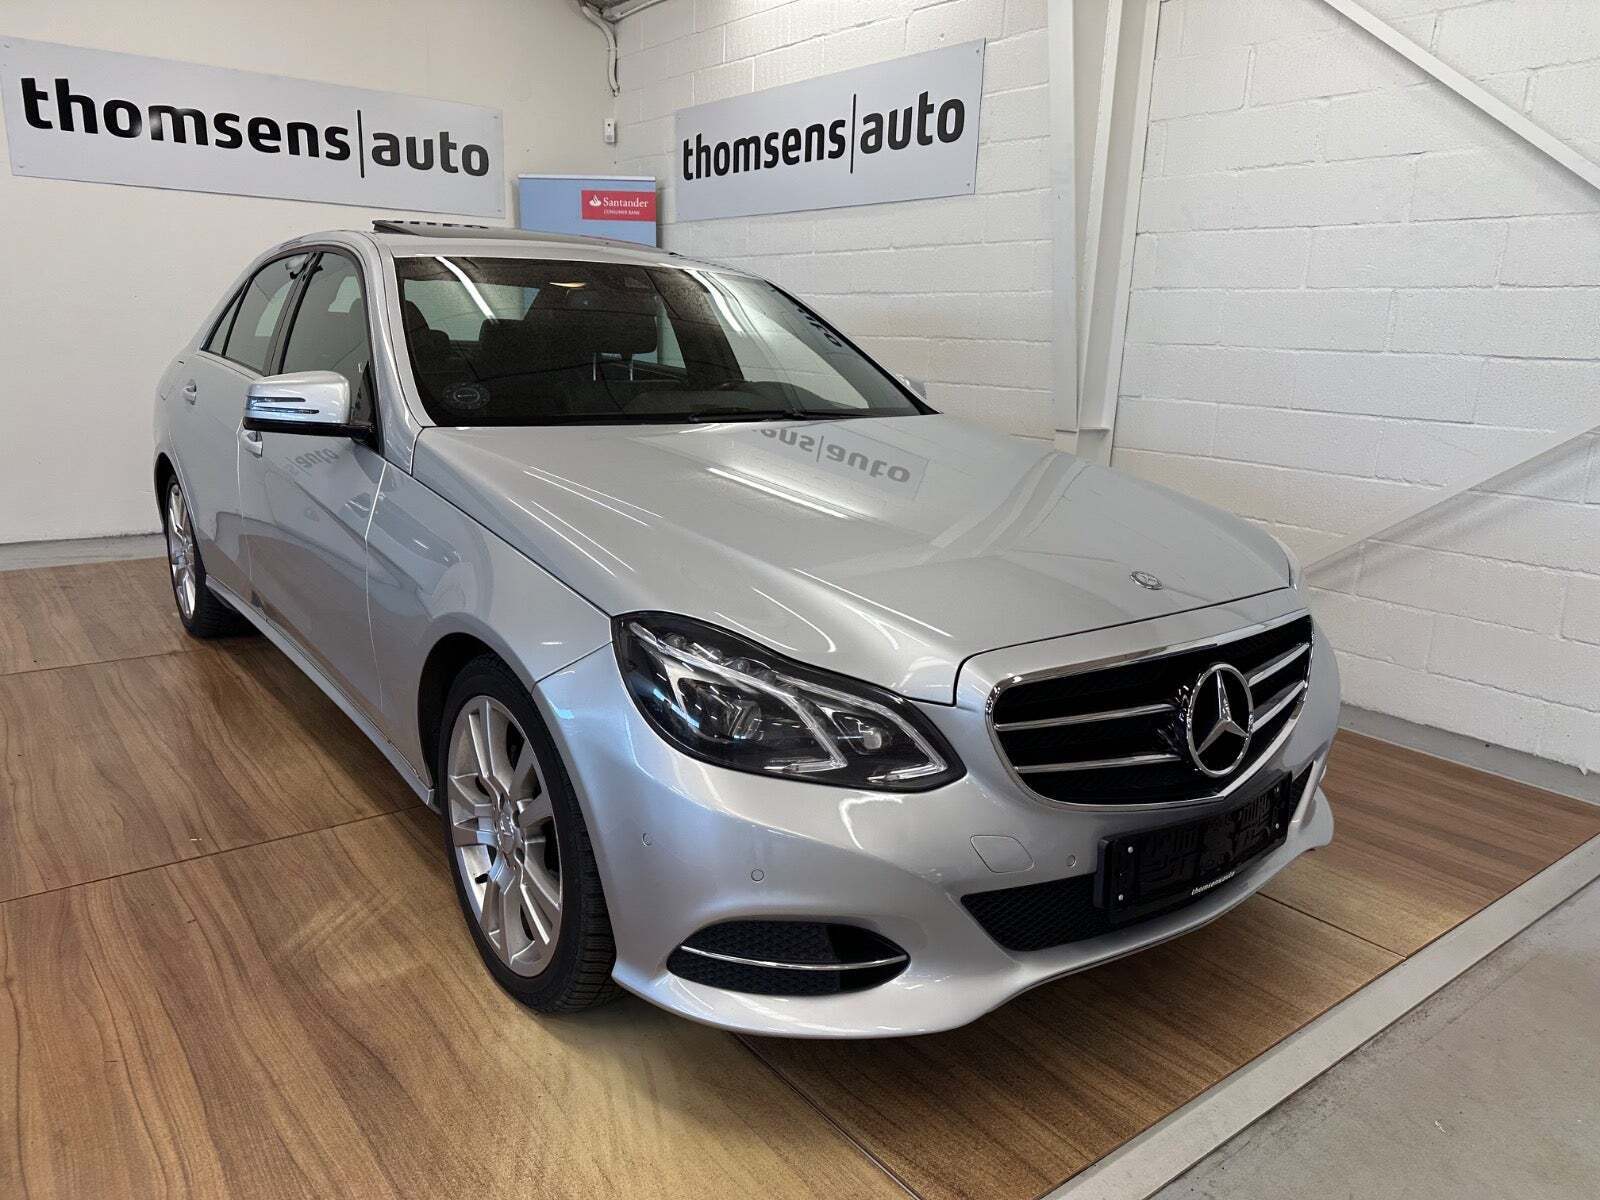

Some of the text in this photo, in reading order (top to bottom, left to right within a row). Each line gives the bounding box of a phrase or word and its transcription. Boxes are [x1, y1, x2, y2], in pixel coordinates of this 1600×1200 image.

[20, 76, 490, 177] thomsens auto
[683, 90, 965, 181] thomsens auto
[603, 197, 648, 208] Santander
